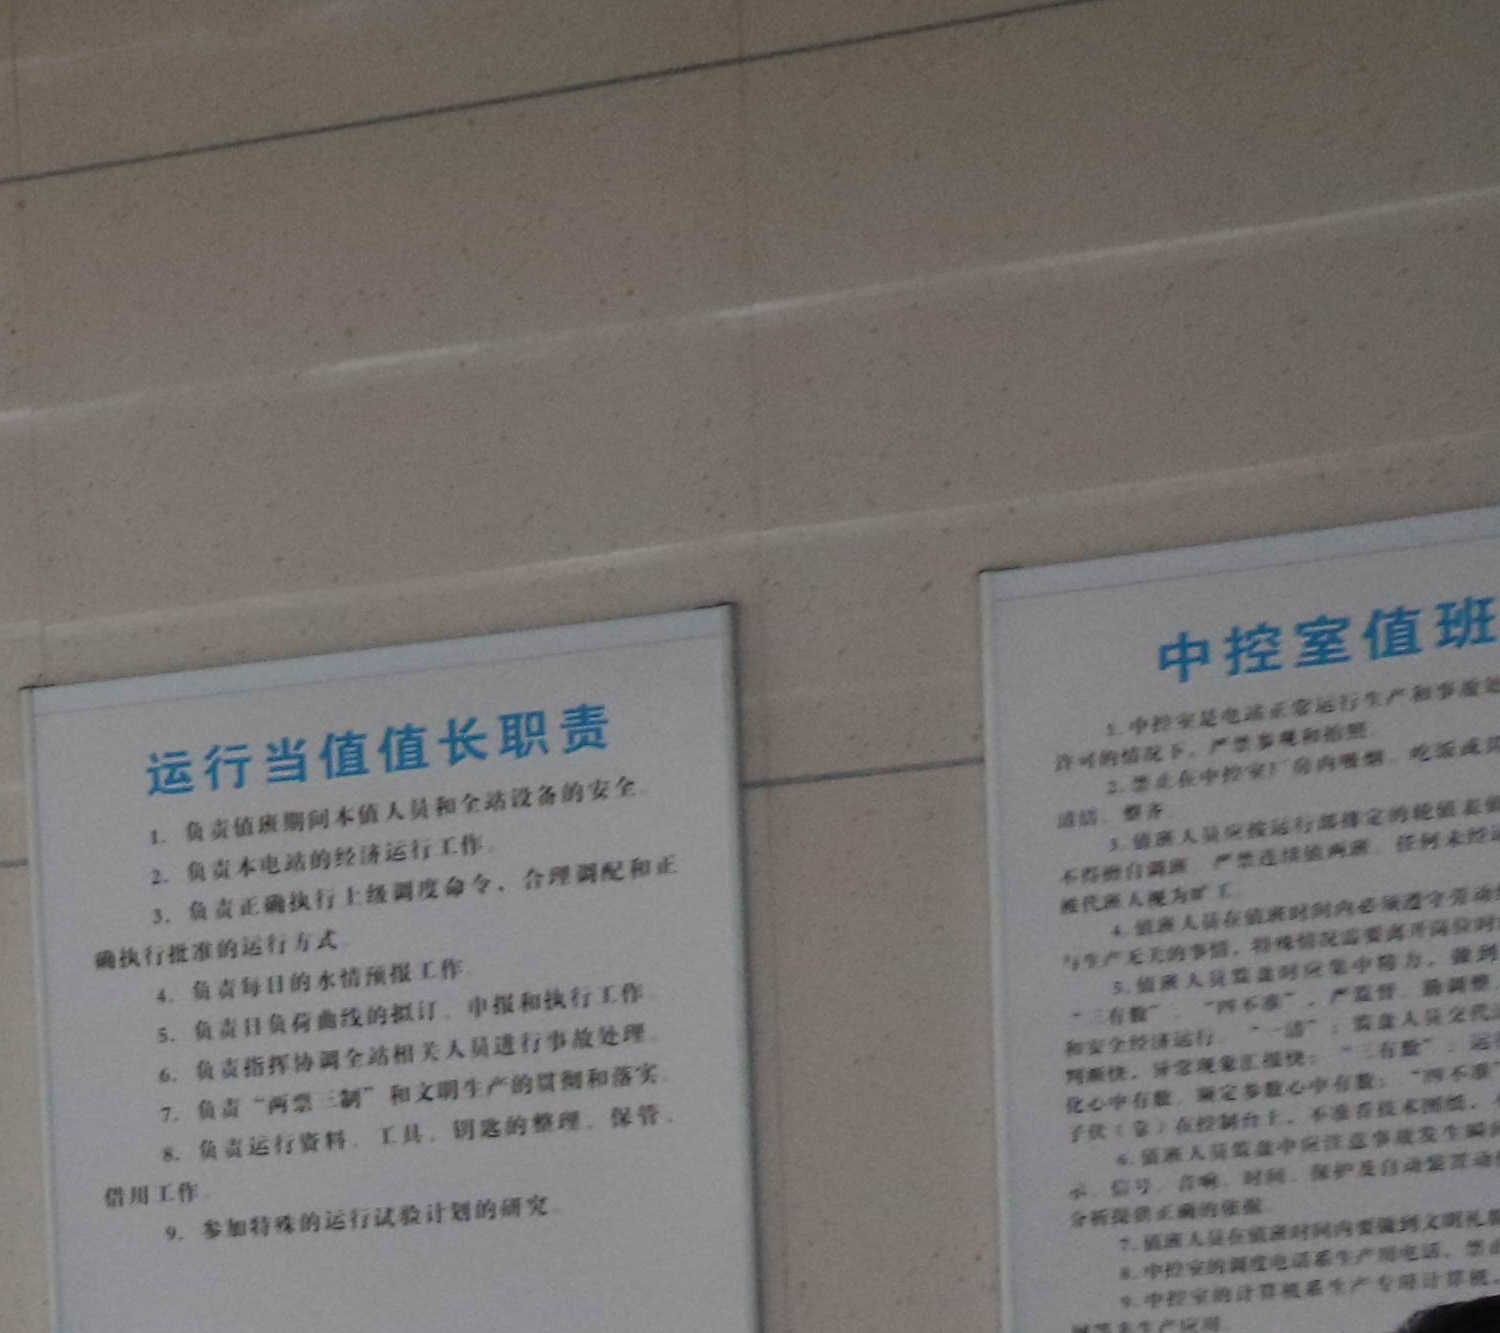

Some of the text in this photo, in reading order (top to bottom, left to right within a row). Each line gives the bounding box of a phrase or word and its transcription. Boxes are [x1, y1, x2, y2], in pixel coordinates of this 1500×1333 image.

[1157, 593, 1498, 686] 中控室值班
[145, 701, 609, 799] 运行当值值长职责
[102, 1178, 206, 1209] 借用工作。
